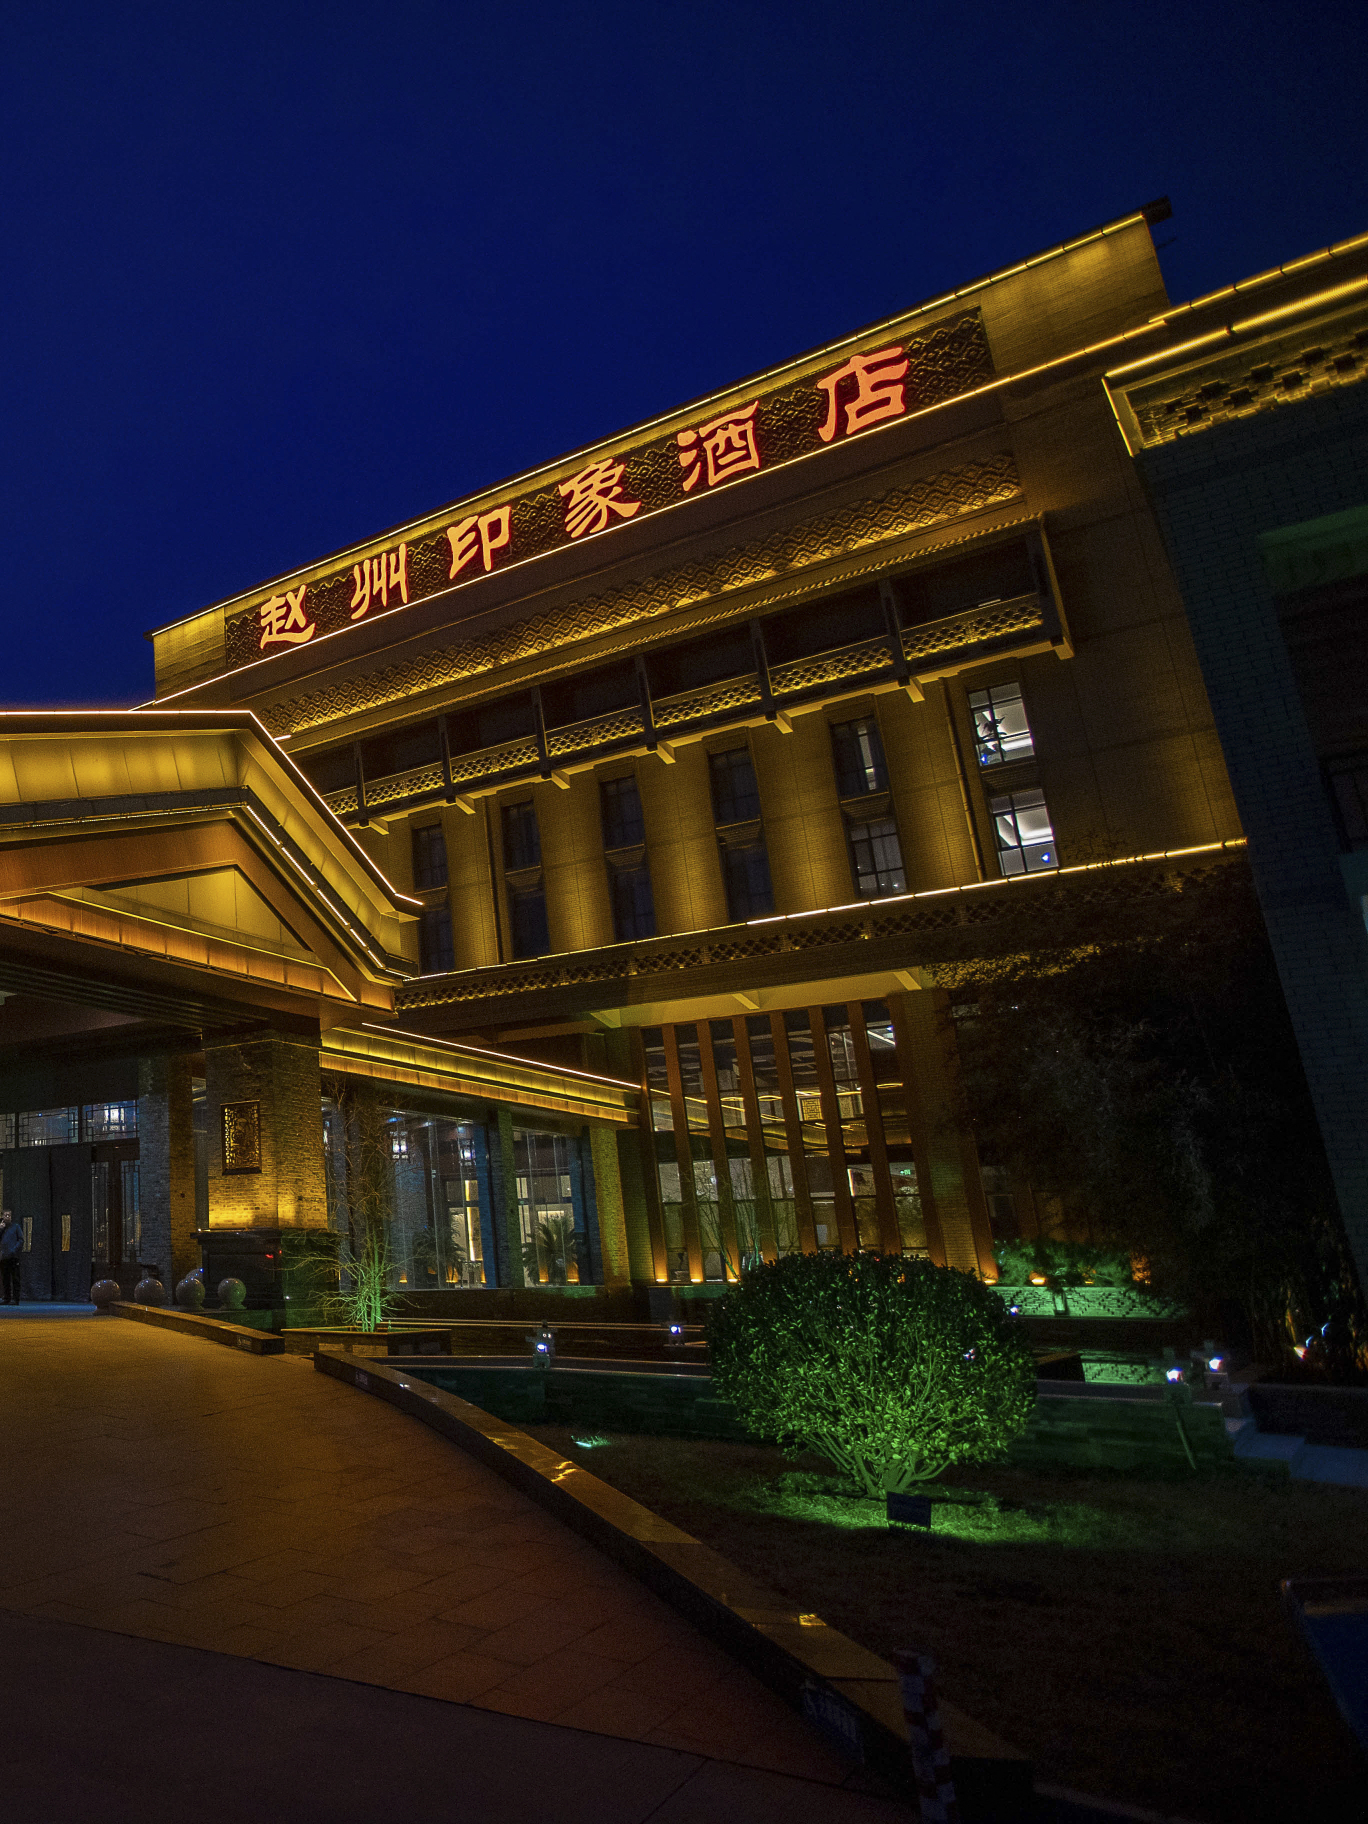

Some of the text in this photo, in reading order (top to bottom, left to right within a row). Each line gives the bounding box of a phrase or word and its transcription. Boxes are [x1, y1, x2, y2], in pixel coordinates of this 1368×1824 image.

[259, 346, 909, 650] 赵州印象酒店
